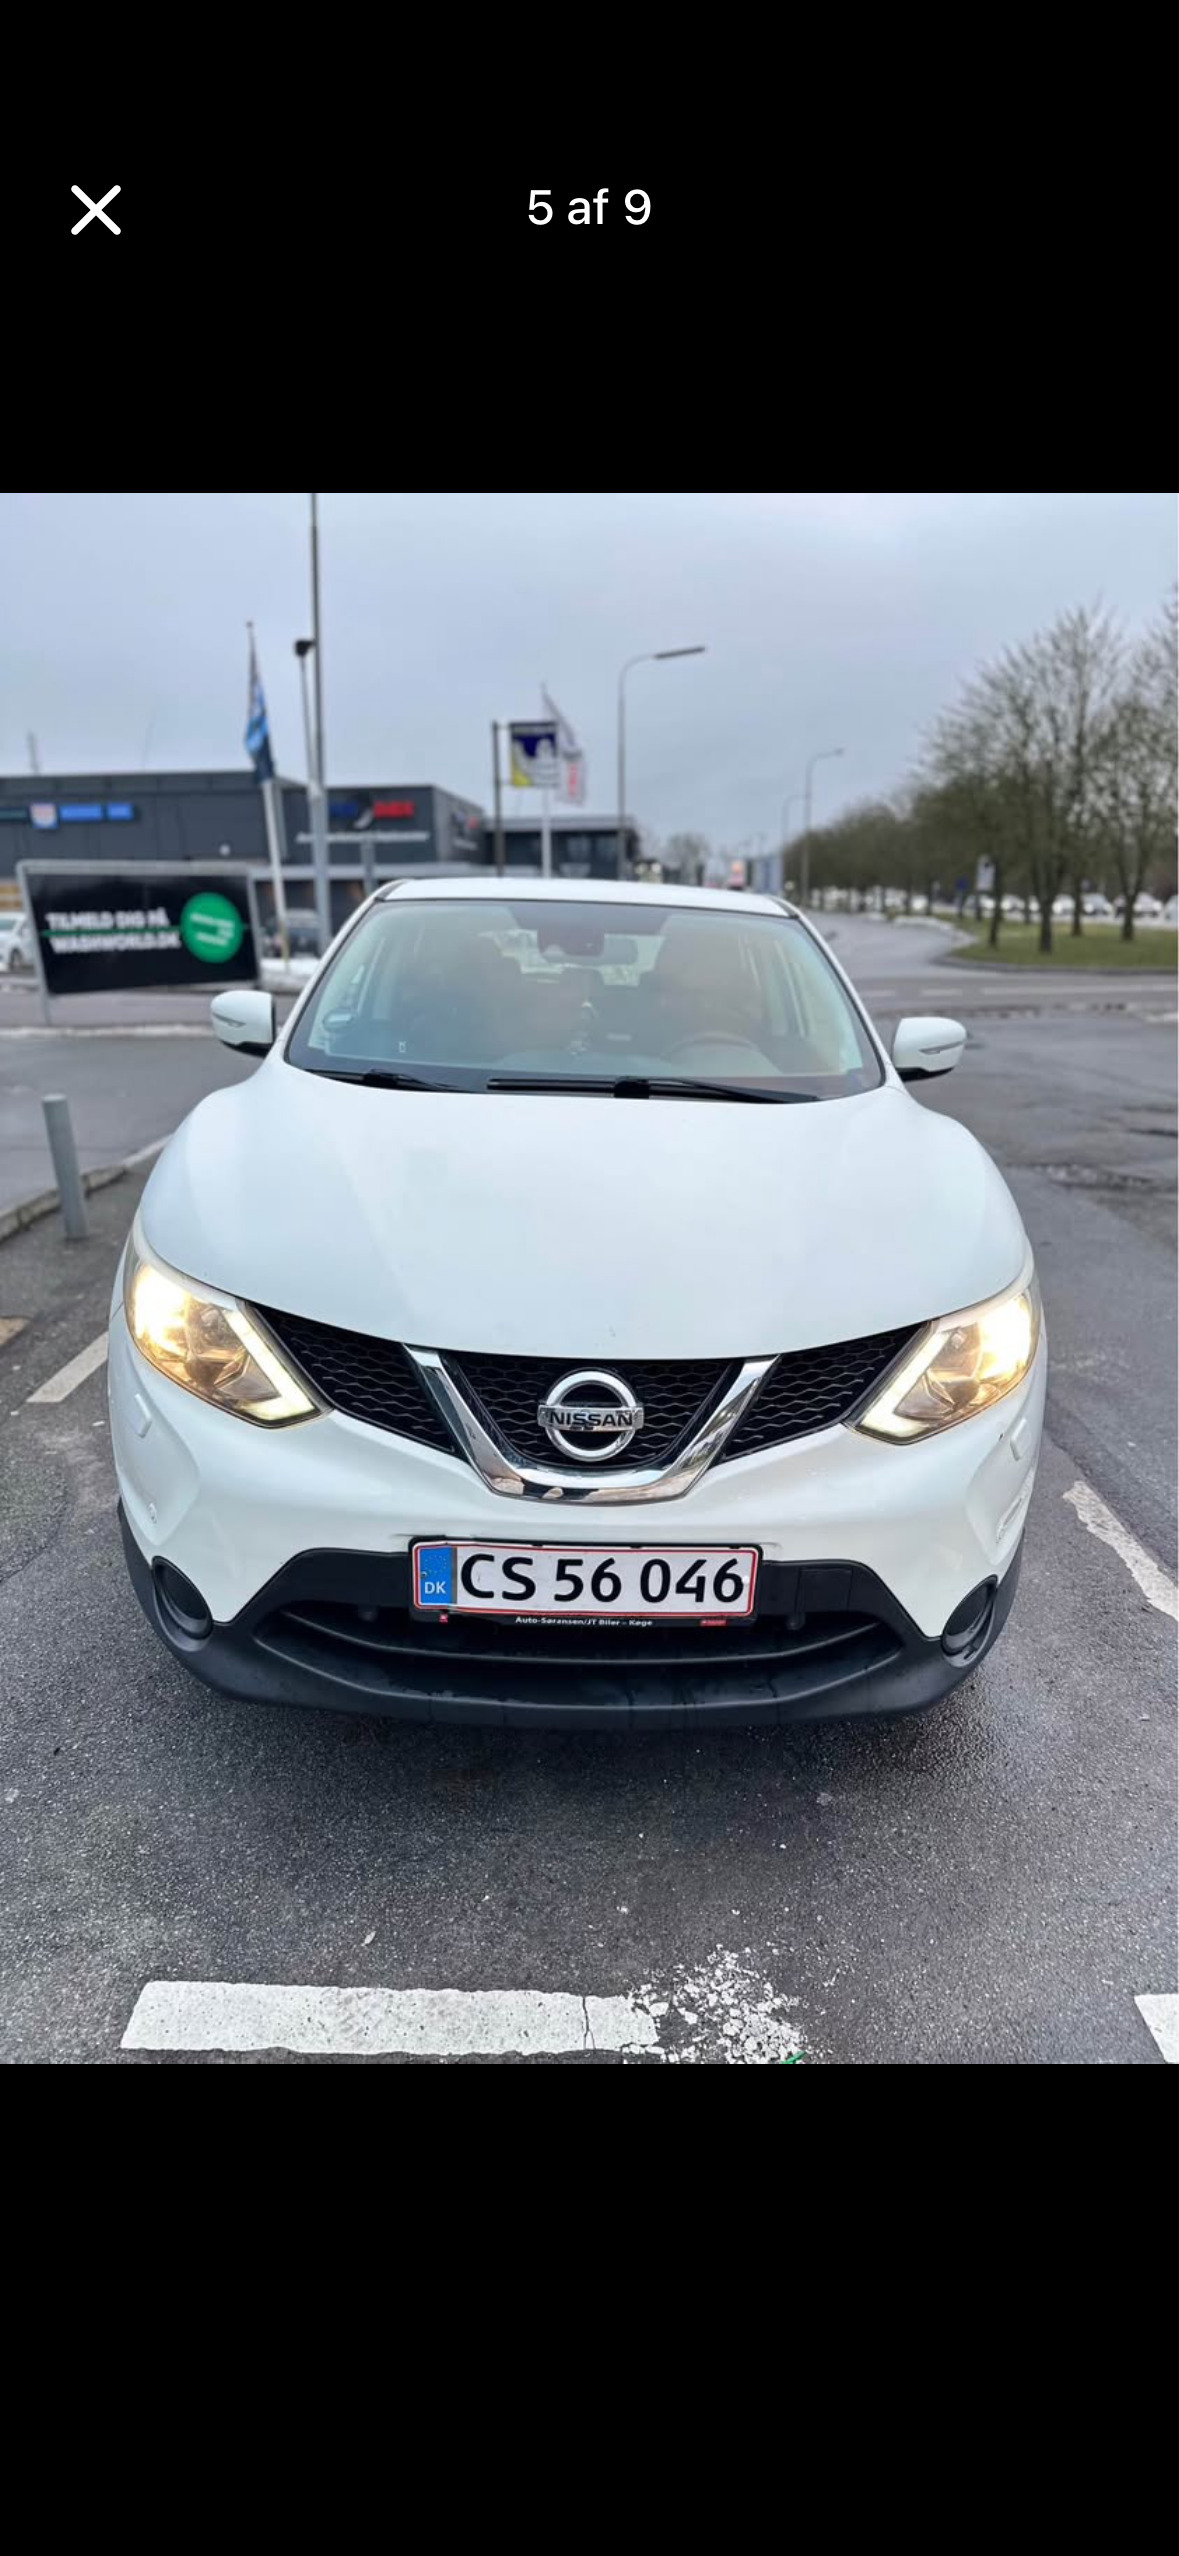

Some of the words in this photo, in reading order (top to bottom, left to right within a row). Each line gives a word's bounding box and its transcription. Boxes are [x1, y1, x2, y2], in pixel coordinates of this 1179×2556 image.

[550, 1411, 632, 1426] NISSAN
[460, 1553, 537, 1601] CS
[554, 1557, 622, 1603] 56
[640, 1558, 744, 1603] 046
[425, 1581, 446, 1594] DK
